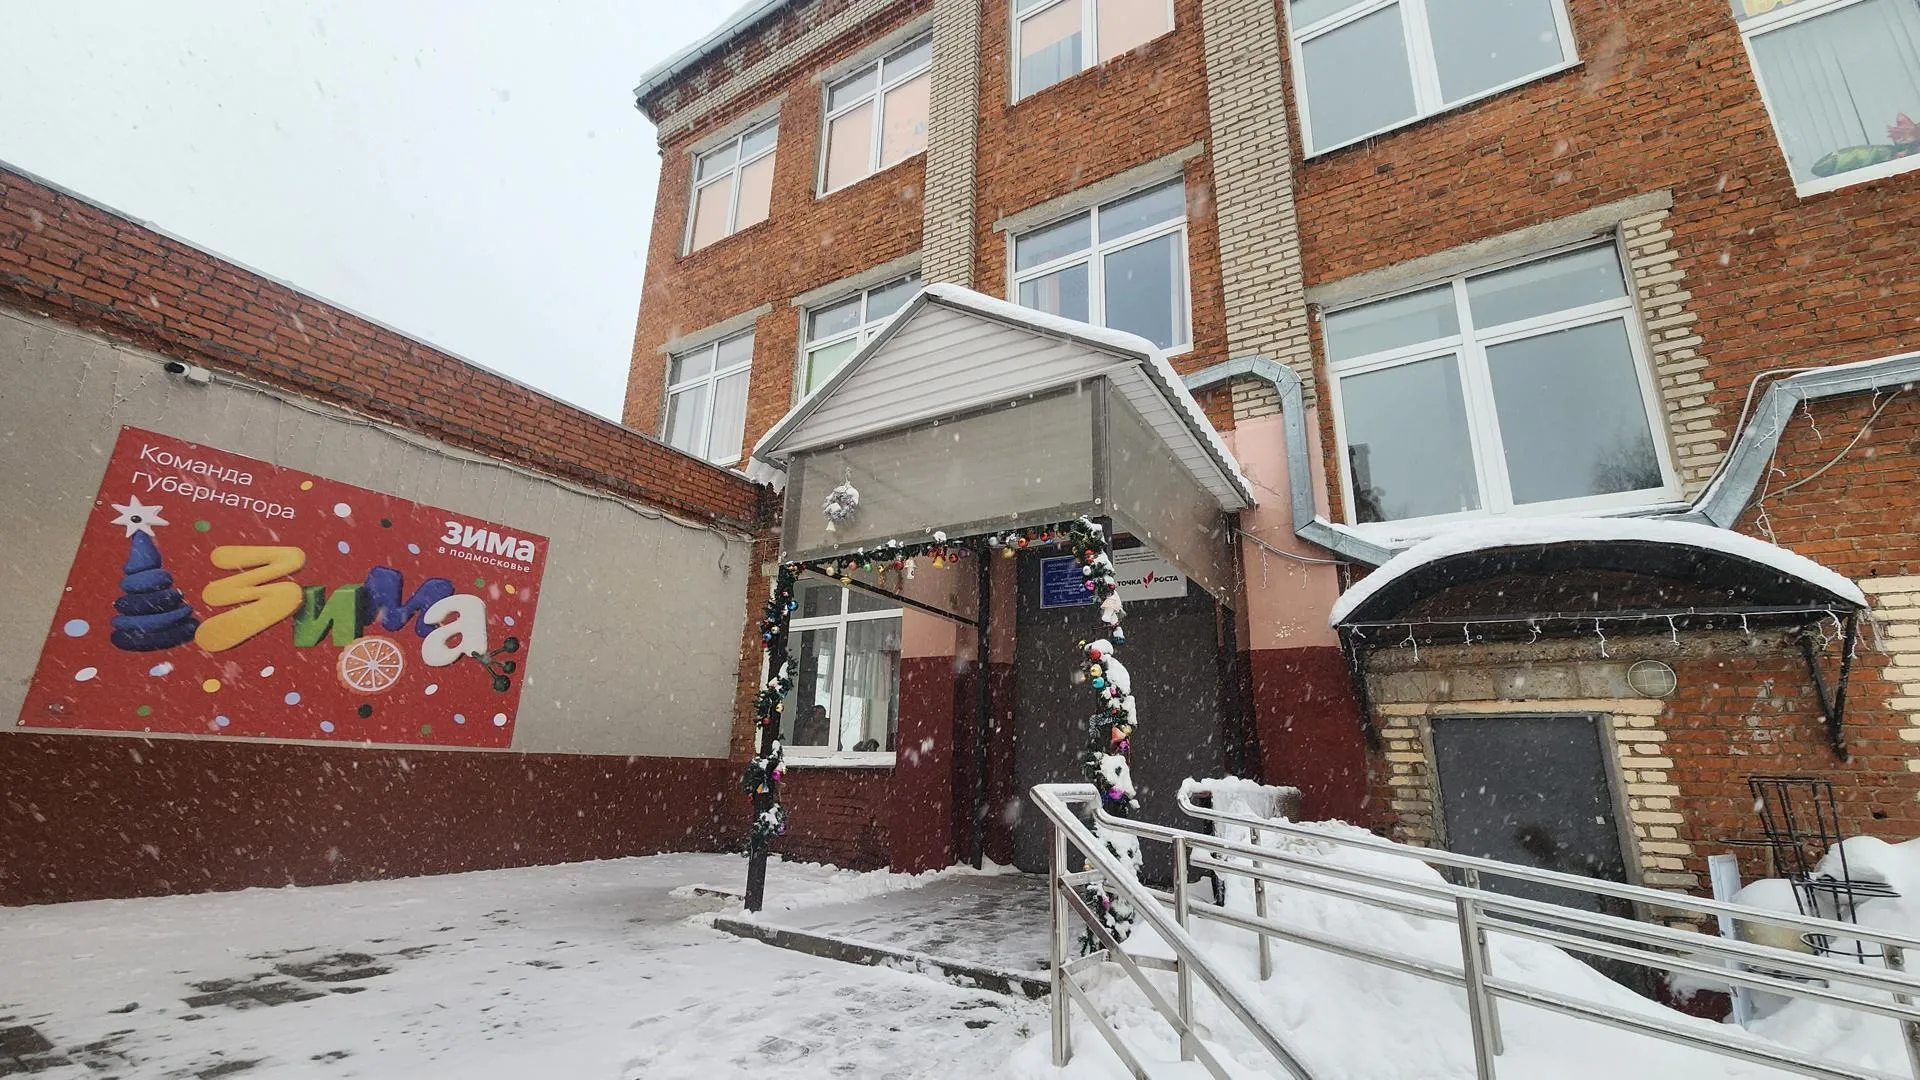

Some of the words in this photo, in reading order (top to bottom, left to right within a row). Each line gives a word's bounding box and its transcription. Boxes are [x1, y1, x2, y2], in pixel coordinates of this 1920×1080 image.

[140, 444, 253, 486] Команда
[131, 471, 296, 520] губернатора
[449, 549, 530, 573] подмосковье
[1117, 579, 1141, 587] ТОЧКА
[1154, 575, 1179, 583] РОСТА
